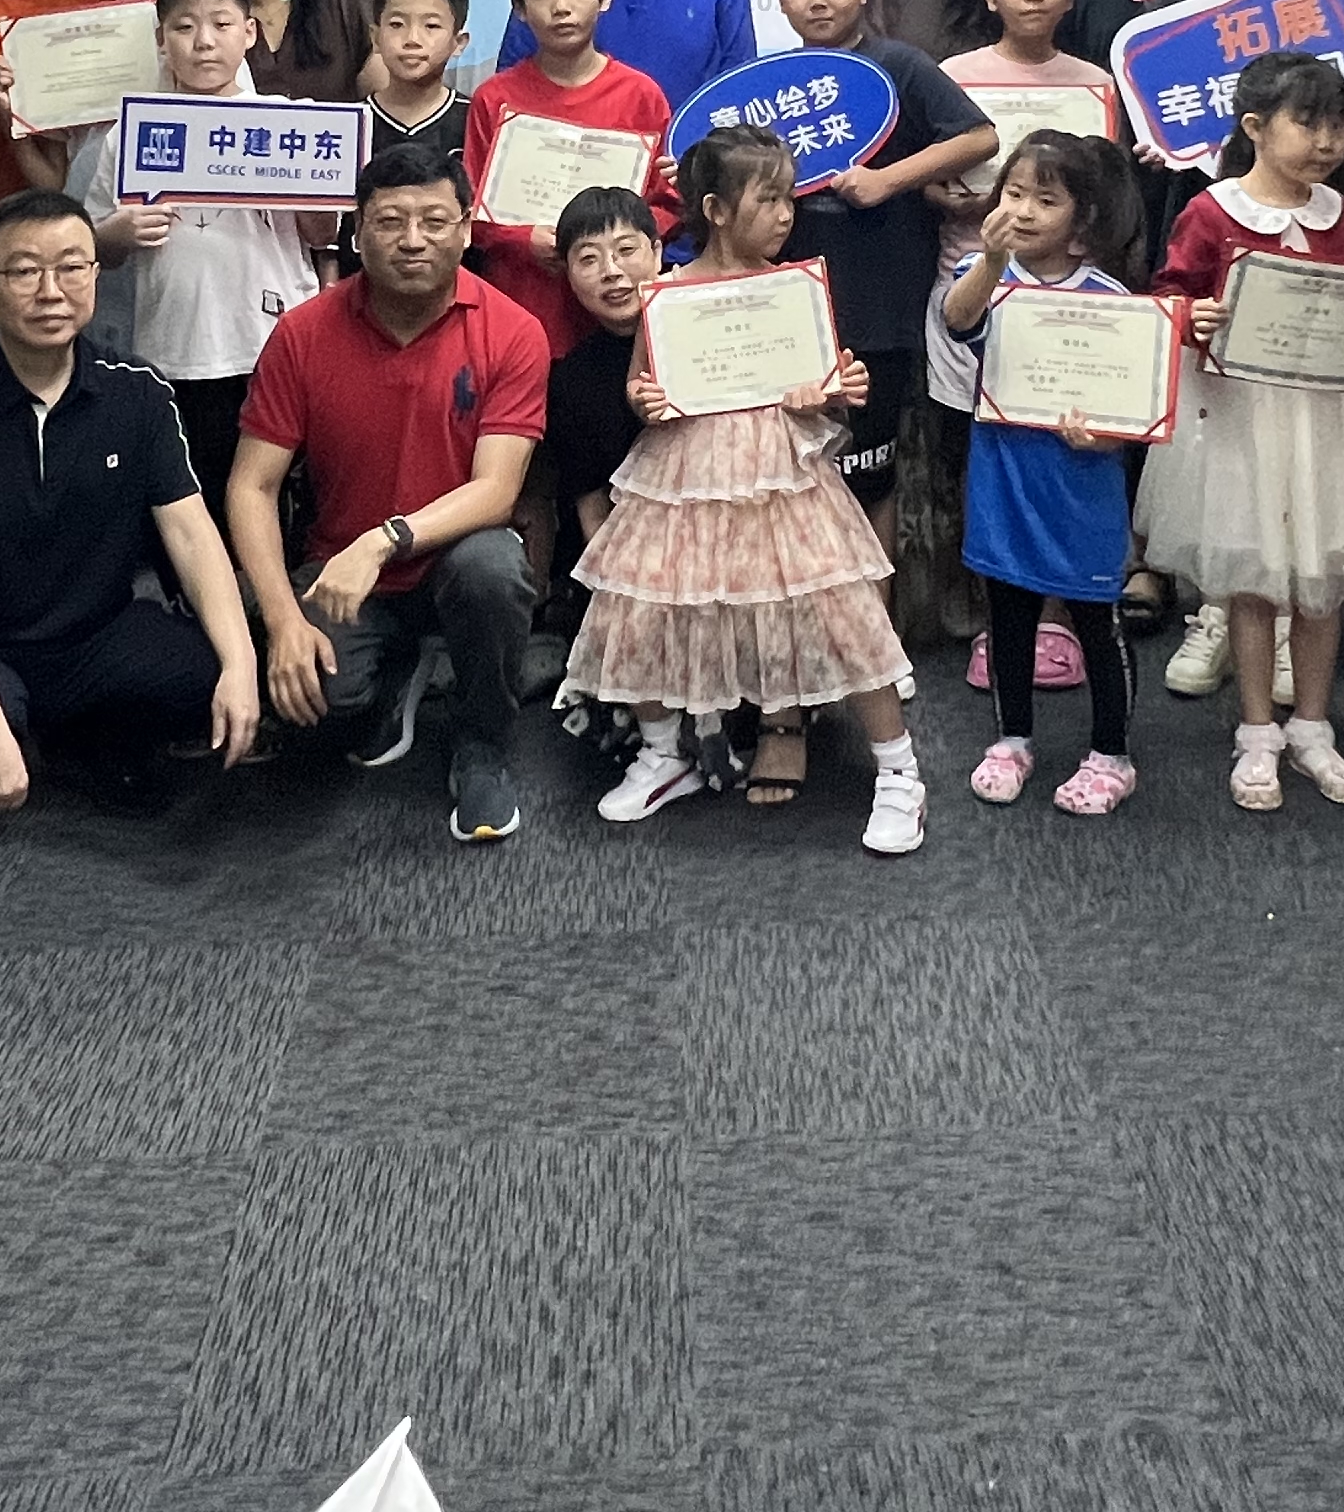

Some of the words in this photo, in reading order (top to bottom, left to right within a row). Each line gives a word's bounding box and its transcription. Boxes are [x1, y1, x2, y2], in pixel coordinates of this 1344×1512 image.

[709, 75, 840, 129] 童心绘梦
[208, 125, 343, 160] 中建中东
[776, 112, 856, 158] 未来
[207, 164, 246, 177] CSCEC
[255, 166, 302, 179] MIDDLE
[310, 168, 342, 181] EAST
